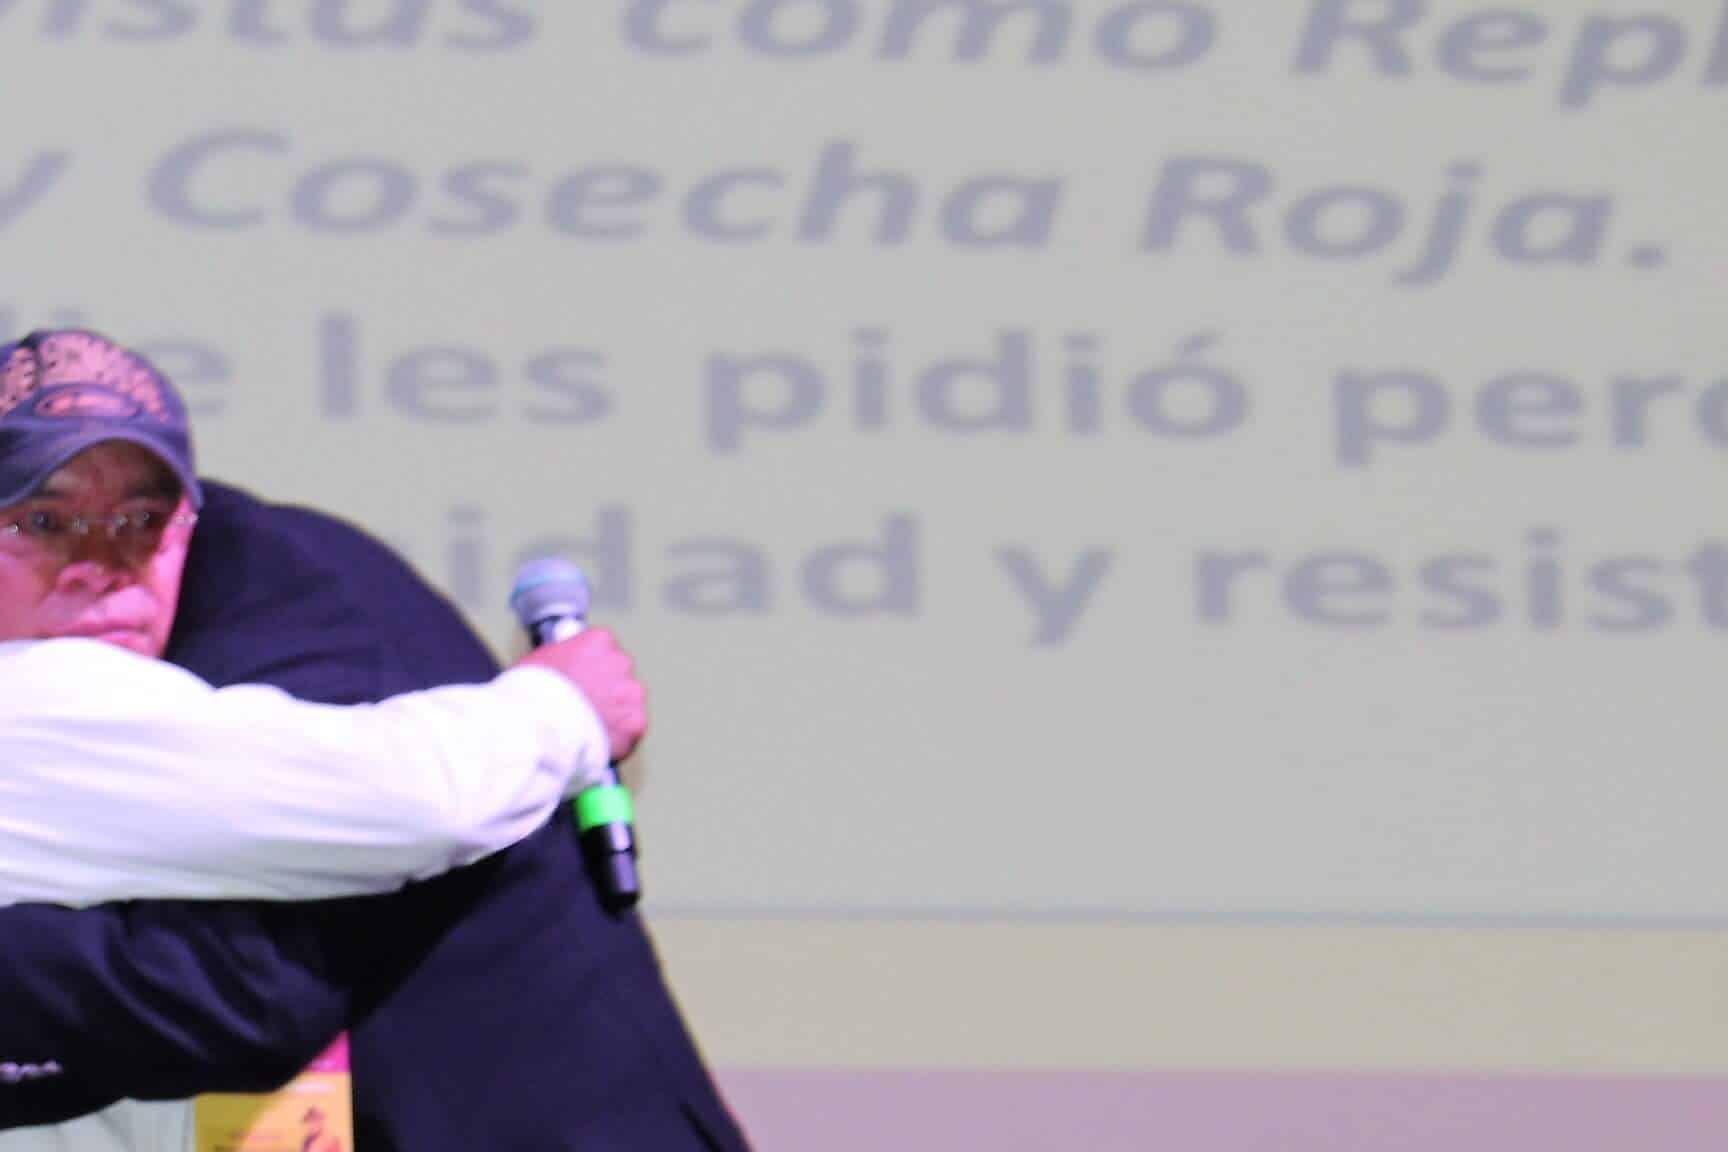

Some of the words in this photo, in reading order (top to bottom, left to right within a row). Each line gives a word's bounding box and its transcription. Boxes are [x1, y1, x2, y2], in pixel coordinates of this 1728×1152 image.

[145, 128, 1069, 252] Cosecha
[1135, 154, 1668, 290] Roja.
[319, 313, 616, 426] les
[701, 327, 1252, 456] pidió
[994, 544, 1116, 650] y
